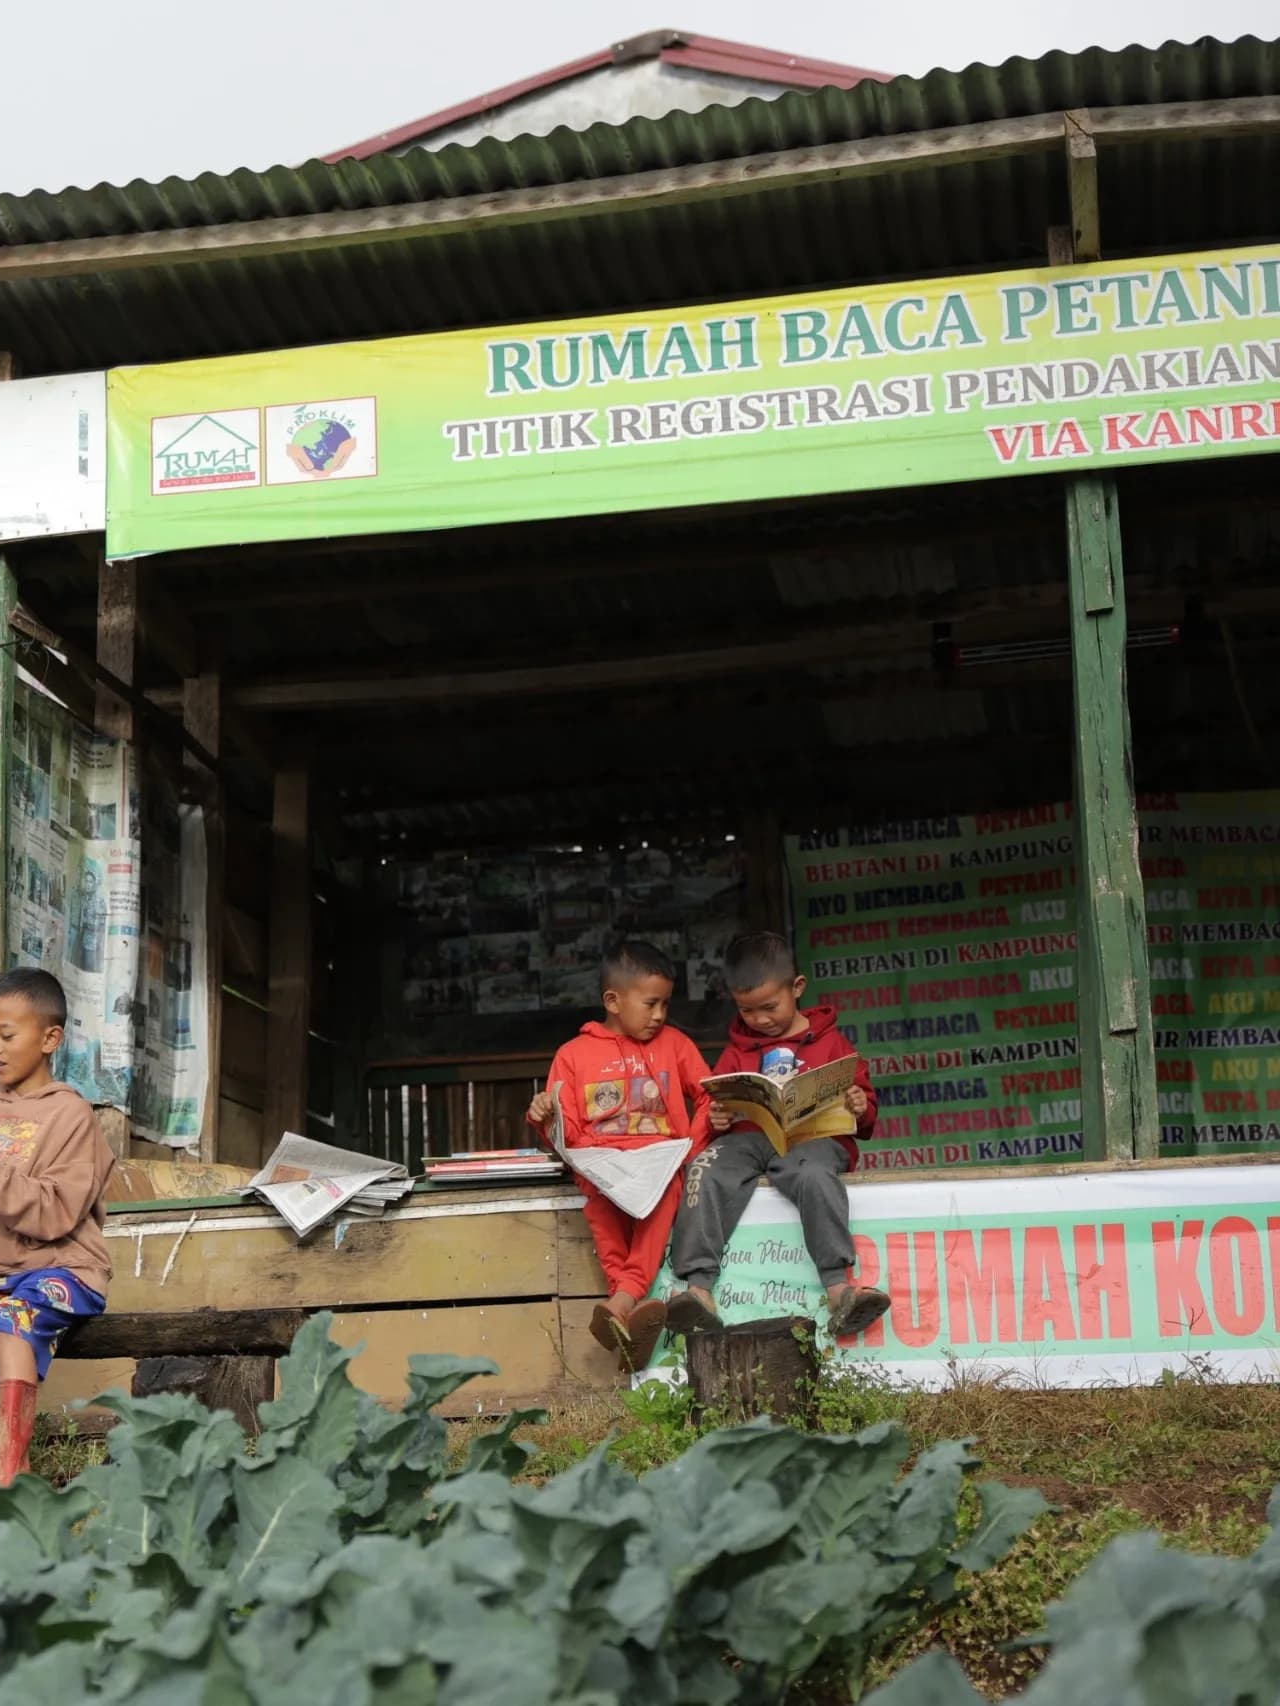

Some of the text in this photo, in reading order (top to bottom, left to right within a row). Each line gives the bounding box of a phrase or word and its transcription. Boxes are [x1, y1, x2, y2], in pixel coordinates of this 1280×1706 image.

[488, 260, 1280, 395] RUMAH BACA PETANI
[447, 342, 1280, 458] TITIK REGISTRASI PENDAKIAN
[164, 448, 249, 472] RUMAH
[988, 421, 1089, 462] VIA
[975, 803, 1056, 835] PETANI
[805, 856, 907, 883] BERTANI
[916, 854, 940, 873] DI
[950, 836, 1073, 868] KAMPUNG
[1169, 824, 1280, 843] MEMBAC
[807, 894, 846, 918] AYO
[855, 881, 966, 911] MEMBACA
[979, 868, 1063, 897] PETANI
[809, 919, 890, 948] PETANI
[897, 907, 1010, 937] MEMBACA
[1021, 900, 1066, 923] AKU
[814, 951, 916, 978] BERTANI
[925, 948, 949, 967] DI
[908, 973, 1023, 1004] MEMBACA
[1028, 966, 1074, 992] AKU
[866, 1012, 981, 1043] MEMBACA
[994, 1005, 1076, 1030] PETANI
[1208, 992, 1255, 1015] AKU
[871, 1053, 928, 1075] TANI
[936, 1050, 962, 1069] DI
[971, 1038, 1077, 1066] KAMPUN
[1187, 1027, 1280, 1048] MEMBA
[876, 1077, 988, 1107] MEMBACA
[1211, 1058, 1260, 1081] AKU
[918, 1105, 1032, 1136] MEMBACA
[1040, 1100, 1081, 1124] AKU
[863, 1147, 936, 1169] RTANI
[943, 1145, 969, 1162] DI
[978, 1133, 1082, 1159] KAMPUN
[721, 1240, 806, 1268] Baca Petani
[719, 1280, 808, 1309] Baca Petani
[836, 1223, 1132, 1349] RUMAH
